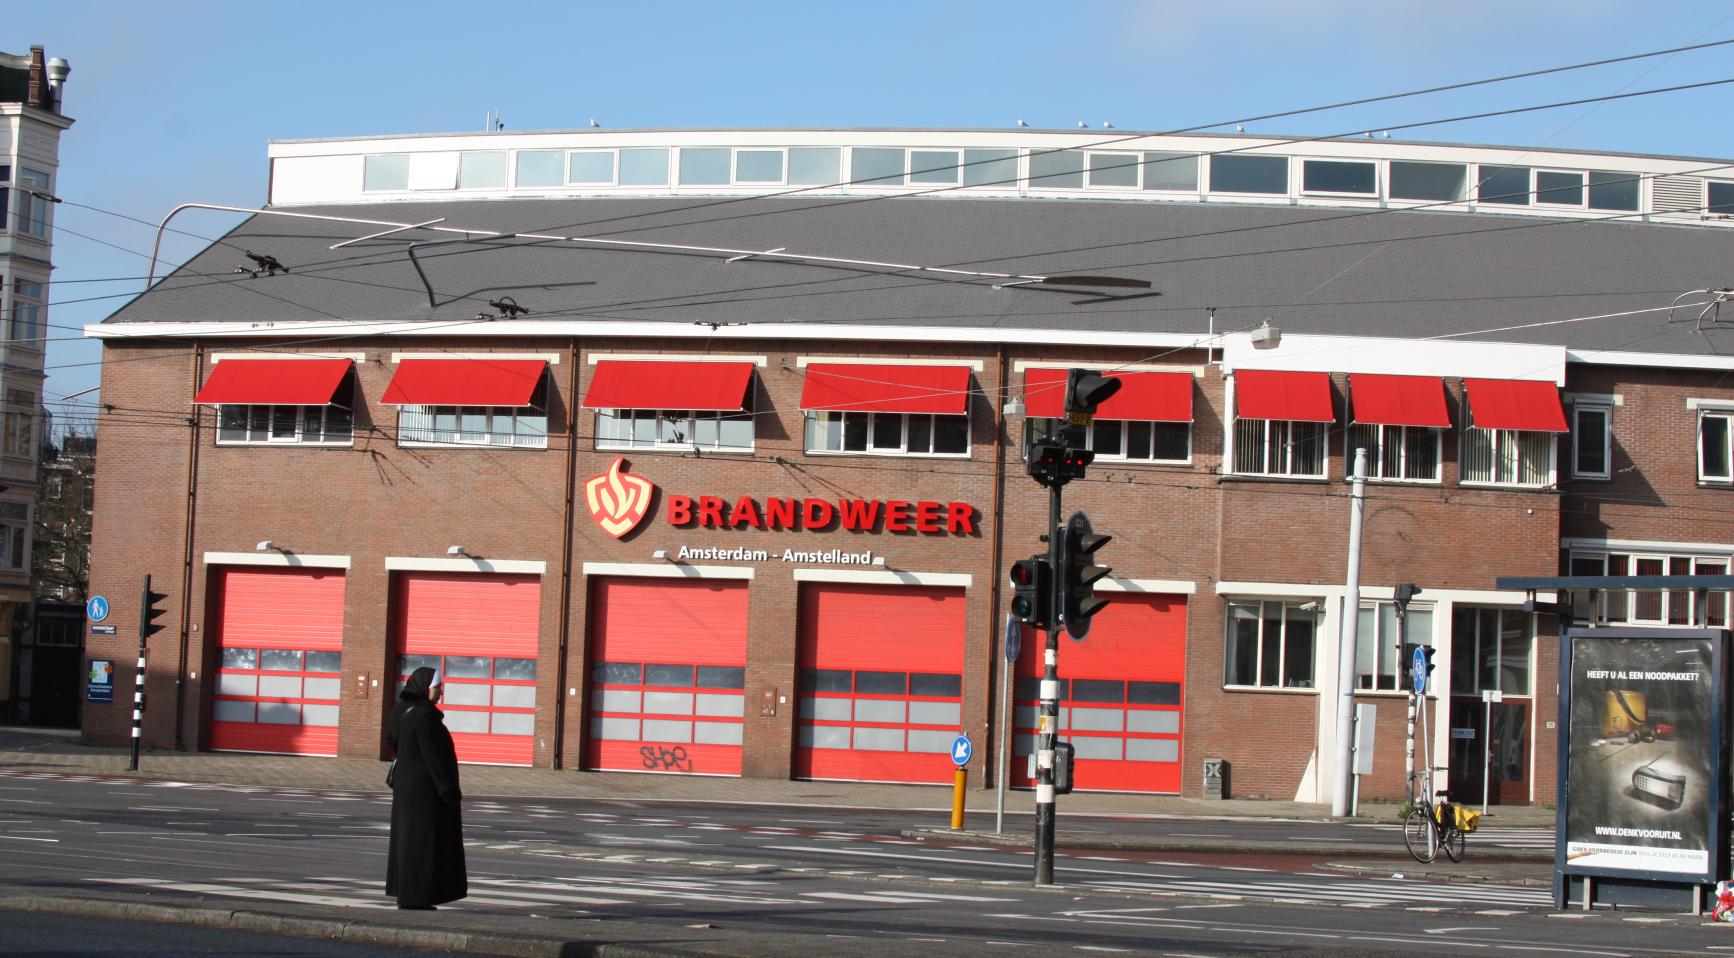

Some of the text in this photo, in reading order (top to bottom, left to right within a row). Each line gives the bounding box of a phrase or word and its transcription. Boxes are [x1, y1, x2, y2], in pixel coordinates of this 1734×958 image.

[667, 495, 974, 534] BRANDWEER
[678, 545, 767, 562] Amsterdam
[782, 548, 871, 566] Amstelland
[1586, 670, 1700, 681] HEEFT U AL EEN NOODPAKKET?
[1595, 826, 1682, 840] WWW.DENKVOORUIT.NL
